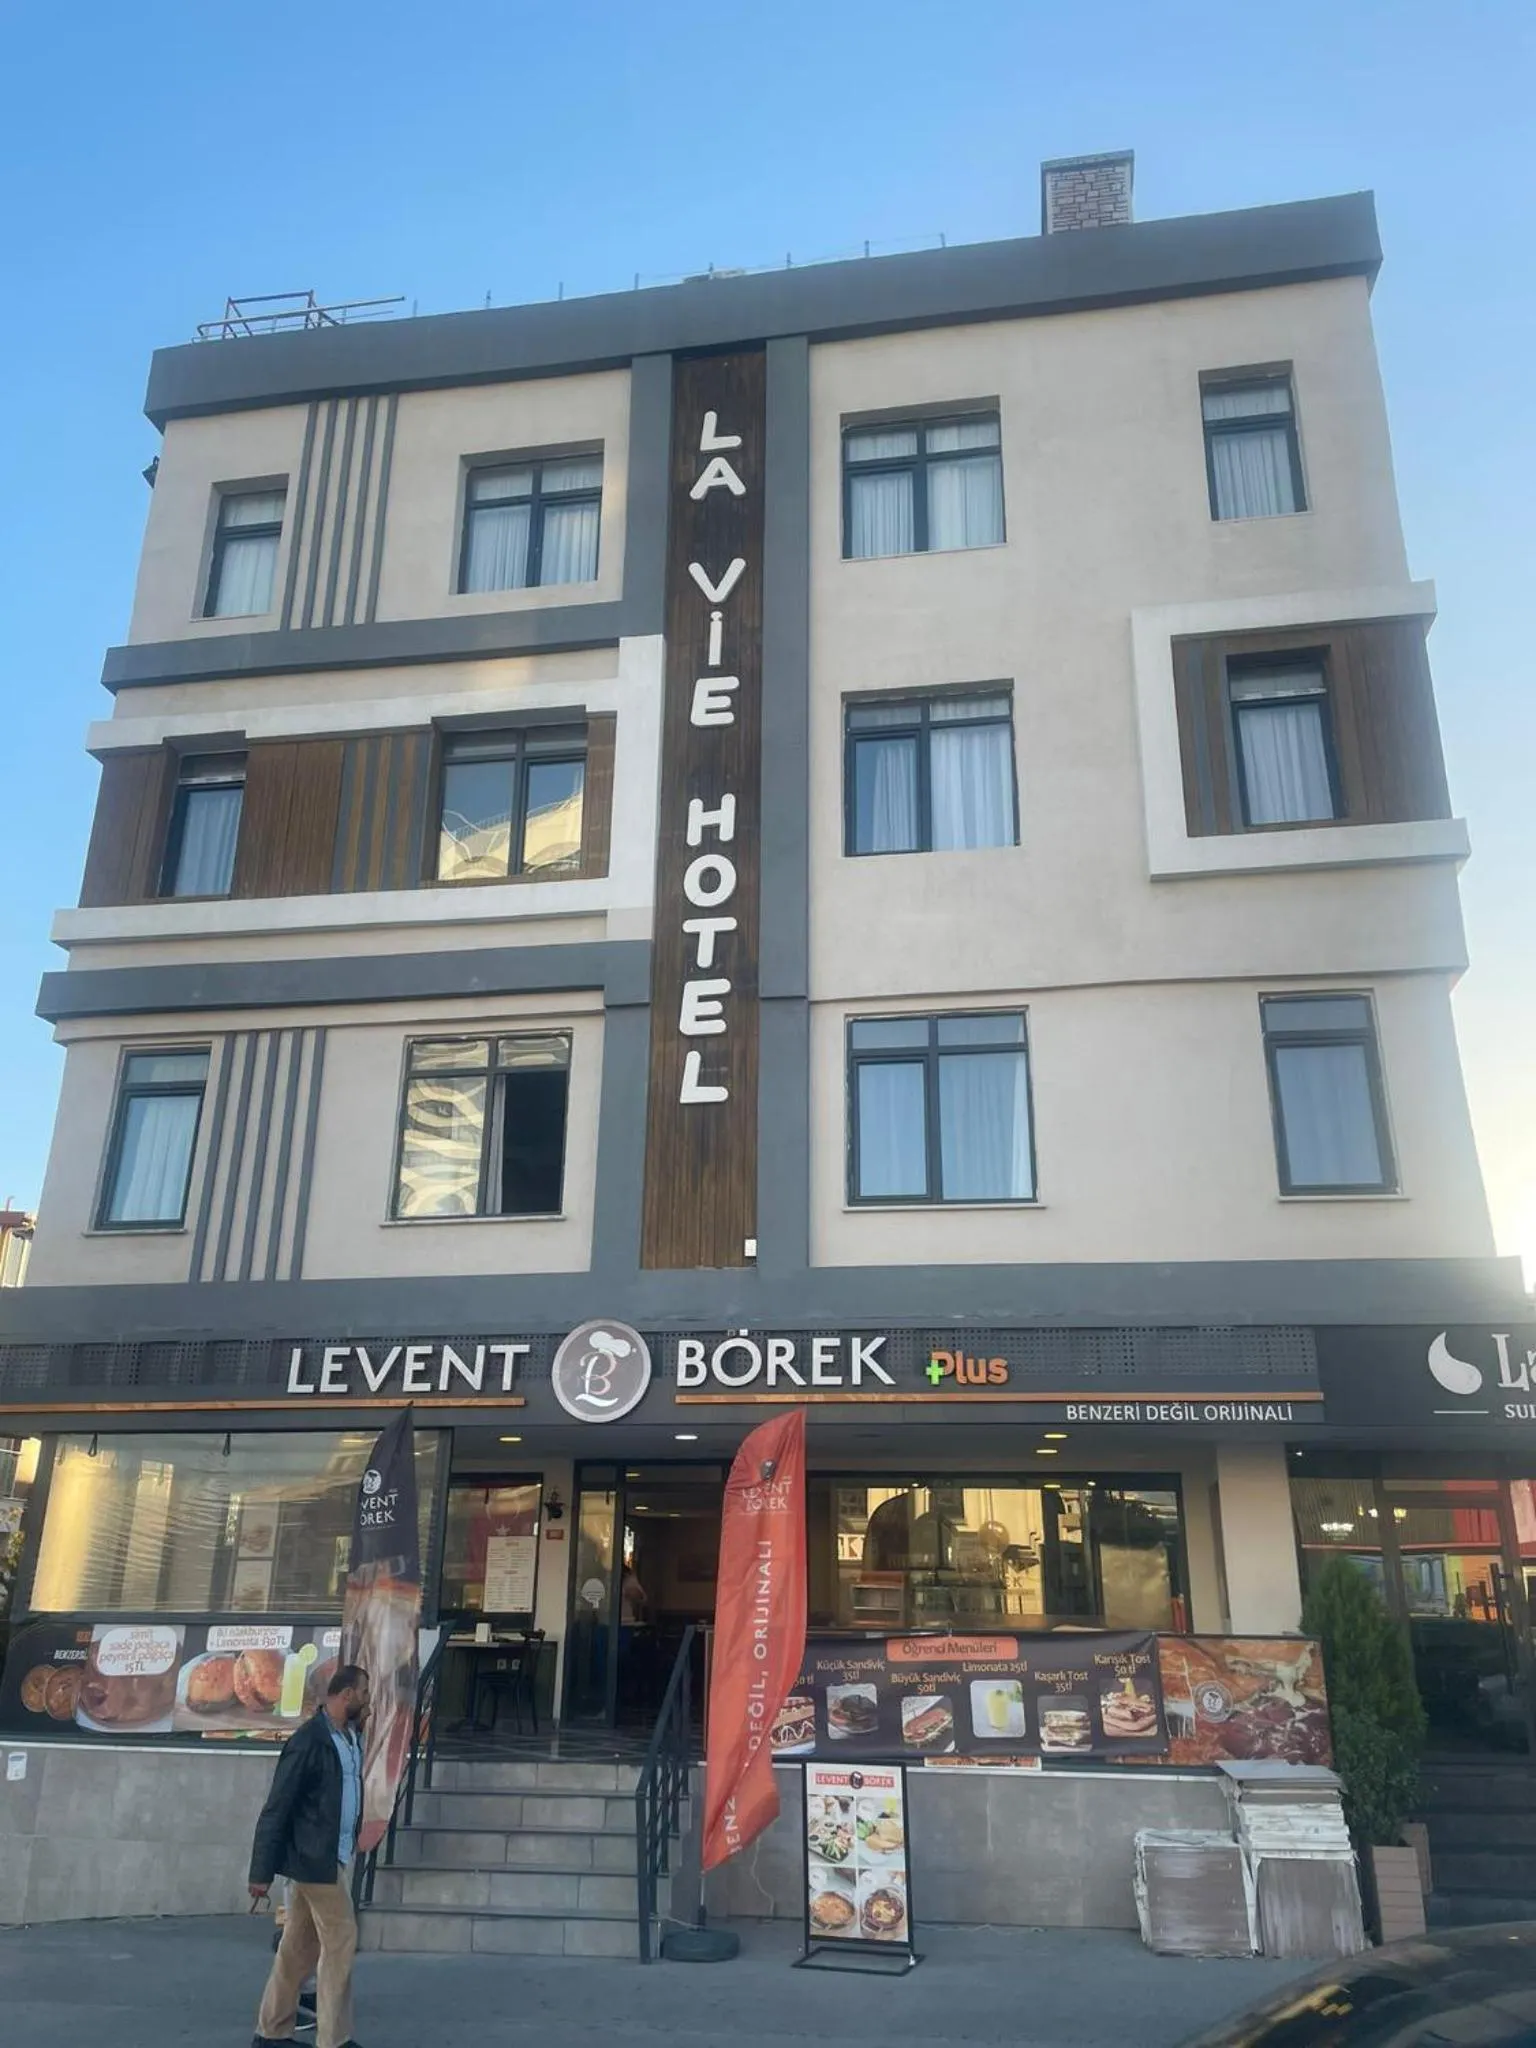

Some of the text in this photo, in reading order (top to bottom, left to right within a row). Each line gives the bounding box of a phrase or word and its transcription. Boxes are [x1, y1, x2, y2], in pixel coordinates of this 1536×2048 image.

[690, 411, 746, 499] LA
[680, 793, 737, 1104] HOTEL
[287, 1328, 896, 1393] LEVENT BÖREK
[927, 1350, 1009, 1385] Plus
[1066, 1403, 1141, 1421] BENZERİ
[1146, 1403, 1199, 1421] DEĞİL
